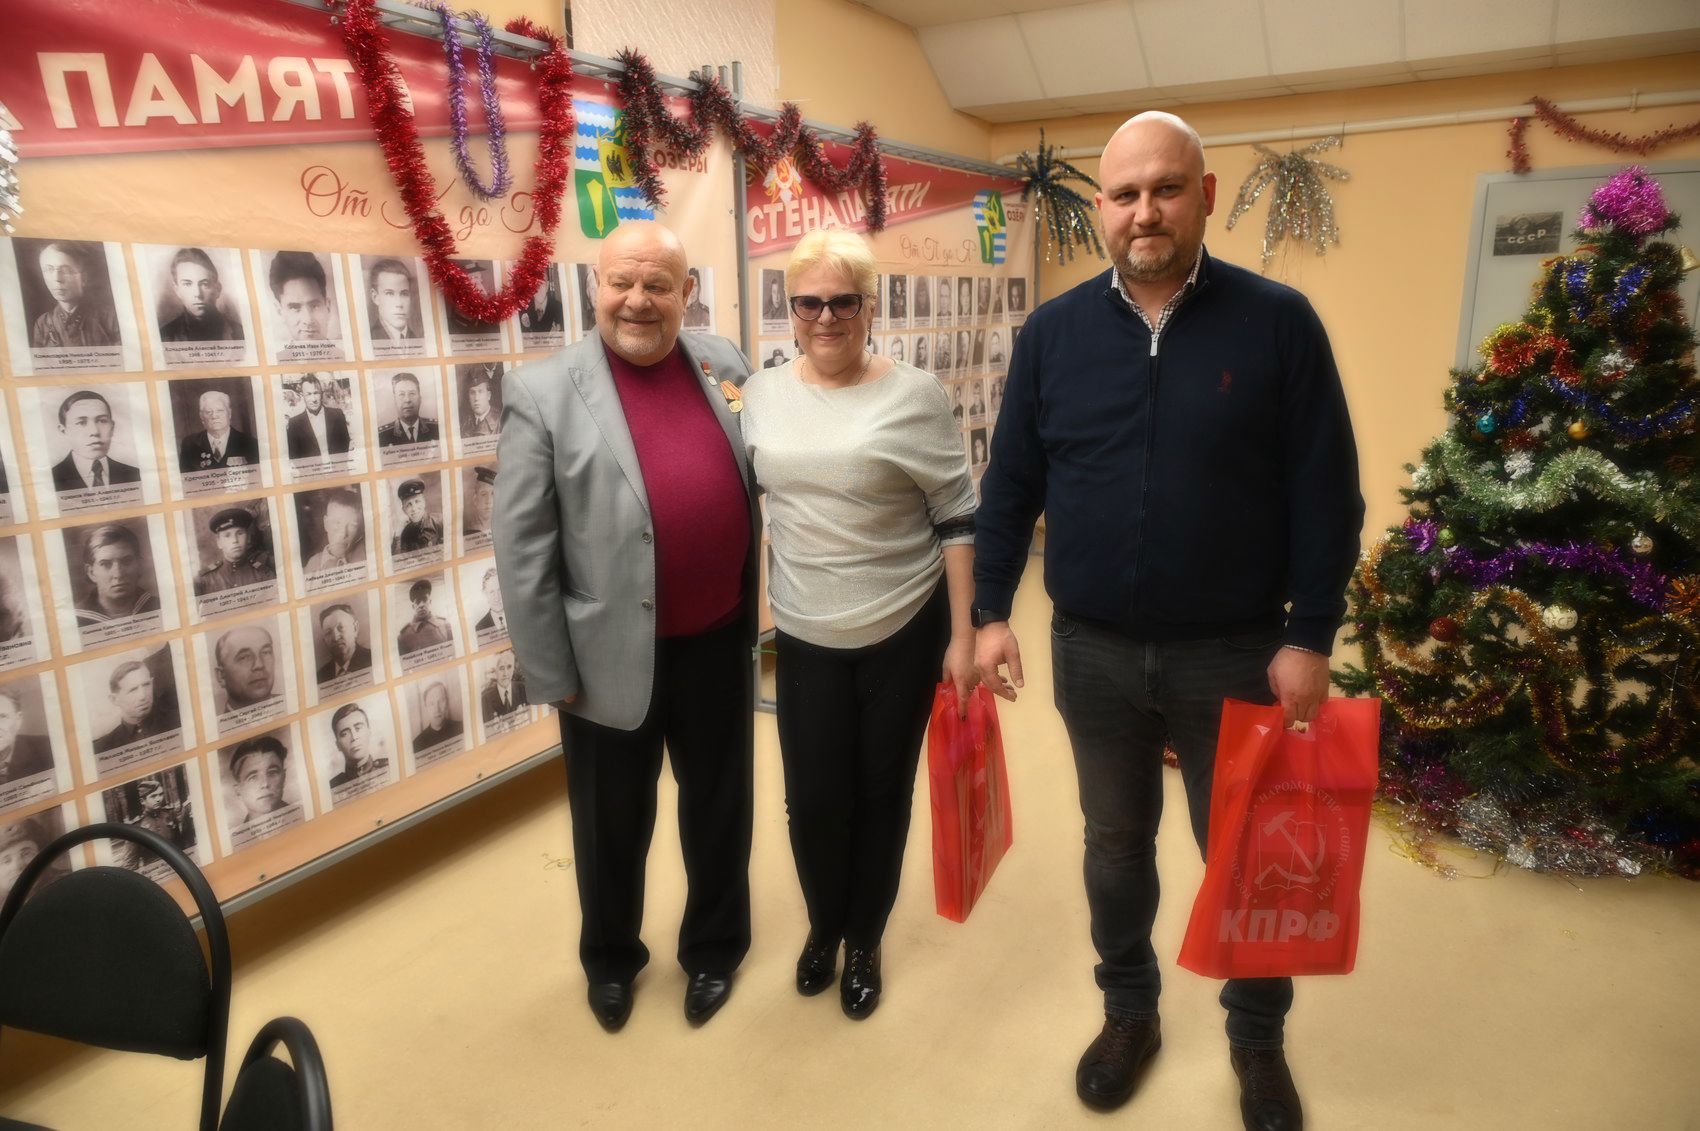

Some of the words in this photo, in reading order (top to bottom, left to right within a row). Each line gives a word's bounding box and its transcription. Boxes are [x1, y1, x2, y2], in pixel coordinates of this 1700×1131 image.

[300, 165, 372, 217] От
[456, 206, 493, 241] до
[747, 196, 843, 244] СТЕНА
[837, 181, 931, 224] ПАЯТИ
[900, 234, 920, 259] От
[1508, 229, 1546, 244] СССР
[1217, 909, 1340, 943] КПРФ
